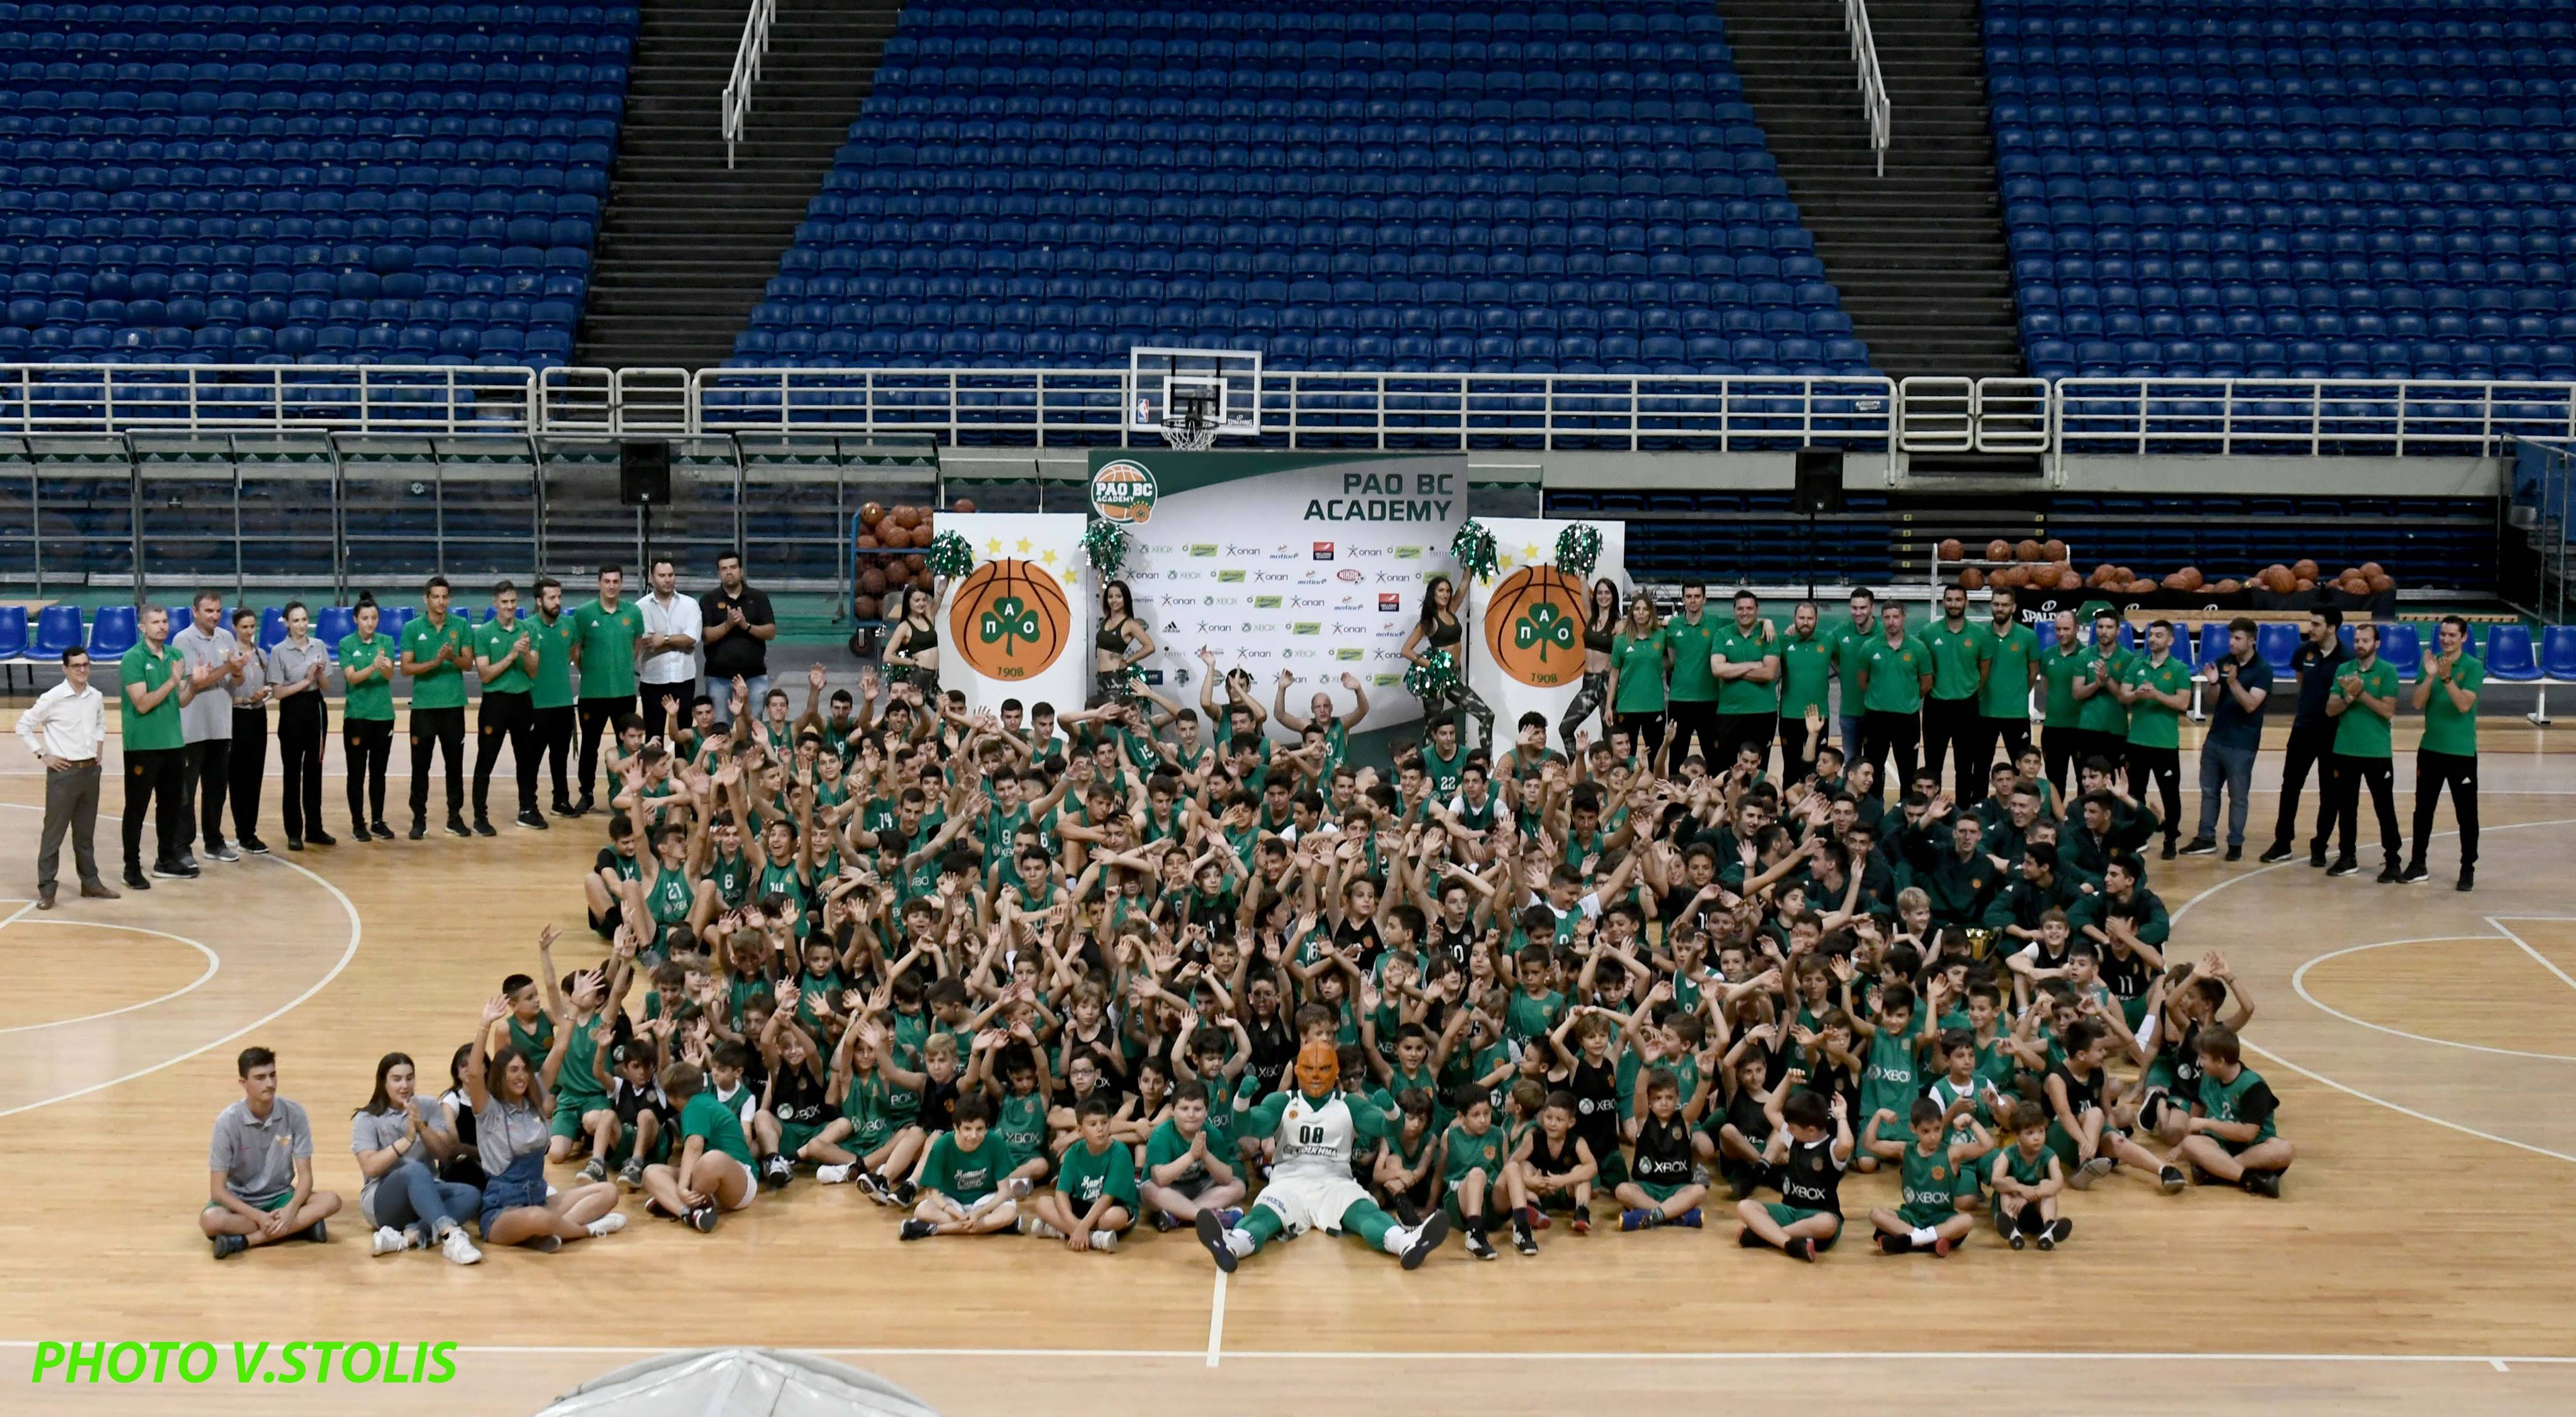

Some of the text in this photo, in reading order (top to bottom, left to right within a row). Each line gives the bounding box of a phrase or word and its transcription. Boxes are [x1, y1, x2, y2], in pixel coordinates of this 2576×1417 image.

[1096, 482, 1153, 497] PAO BC
[1344, 474, 1453, 494] PAO BC
[1304, 500, 1453, 521] ACADEMY
[2022, 608, 2068, 623] SPALD
[997, 667, 1024, 677] 1908
[1531, 672, 1558, 684] 1908
[1139, 747, 1155, 759] 15
[1440, 776, 1456, 791] 22
[879, 812, 892, 828] 14
[1002, 830, 1011, 845] 9
[1001, 847, 1014, 857] XB
[911, 876, 929, 887] BO
[668, 882, 683, 900] 21
[672, 901, 688, 912] XB
[2118, 975, 2134, 994] 11
[1377, 1040, 1393, 1053] XB
[1883, 1068, 1911, 1082] XBO
[891, 1092, 912, 1106] BOX
[1596, 1101, 1616, 1113] XBO
[1208, 1114, 1230, 1128] XBO
[1006, 1131, 1041, 1145] XBOX
[1299, 1125, 1324, 1144] 08
[1653, 1160, 1689, 1173] XBOX
[1791, 1184, 1826, 1201] XBOX
[1915, 1192, 1950, 1204] XBOX
